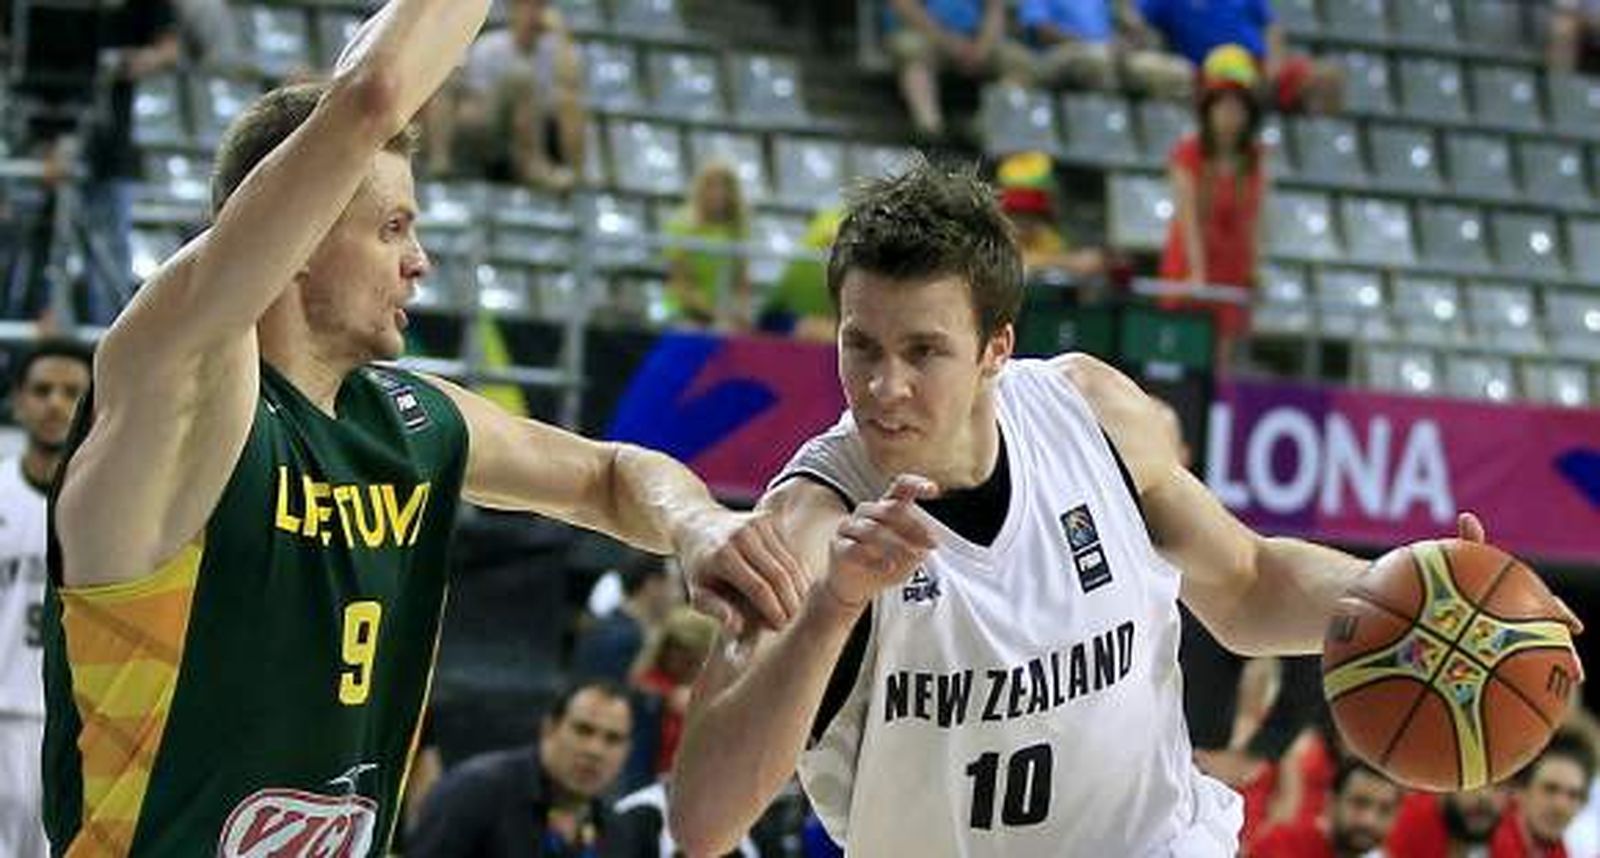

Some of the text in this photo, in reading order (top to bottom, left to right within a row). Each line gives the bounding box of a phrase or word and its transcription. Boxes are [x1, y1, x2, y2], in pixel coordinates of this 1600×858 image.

[1206, 402, 1455, 524] LONA
[338, 600, 382, 705] 9
[884, 620, 1135, 729] NEW ZEALAND
[966, 742, 1053, 830] 10
